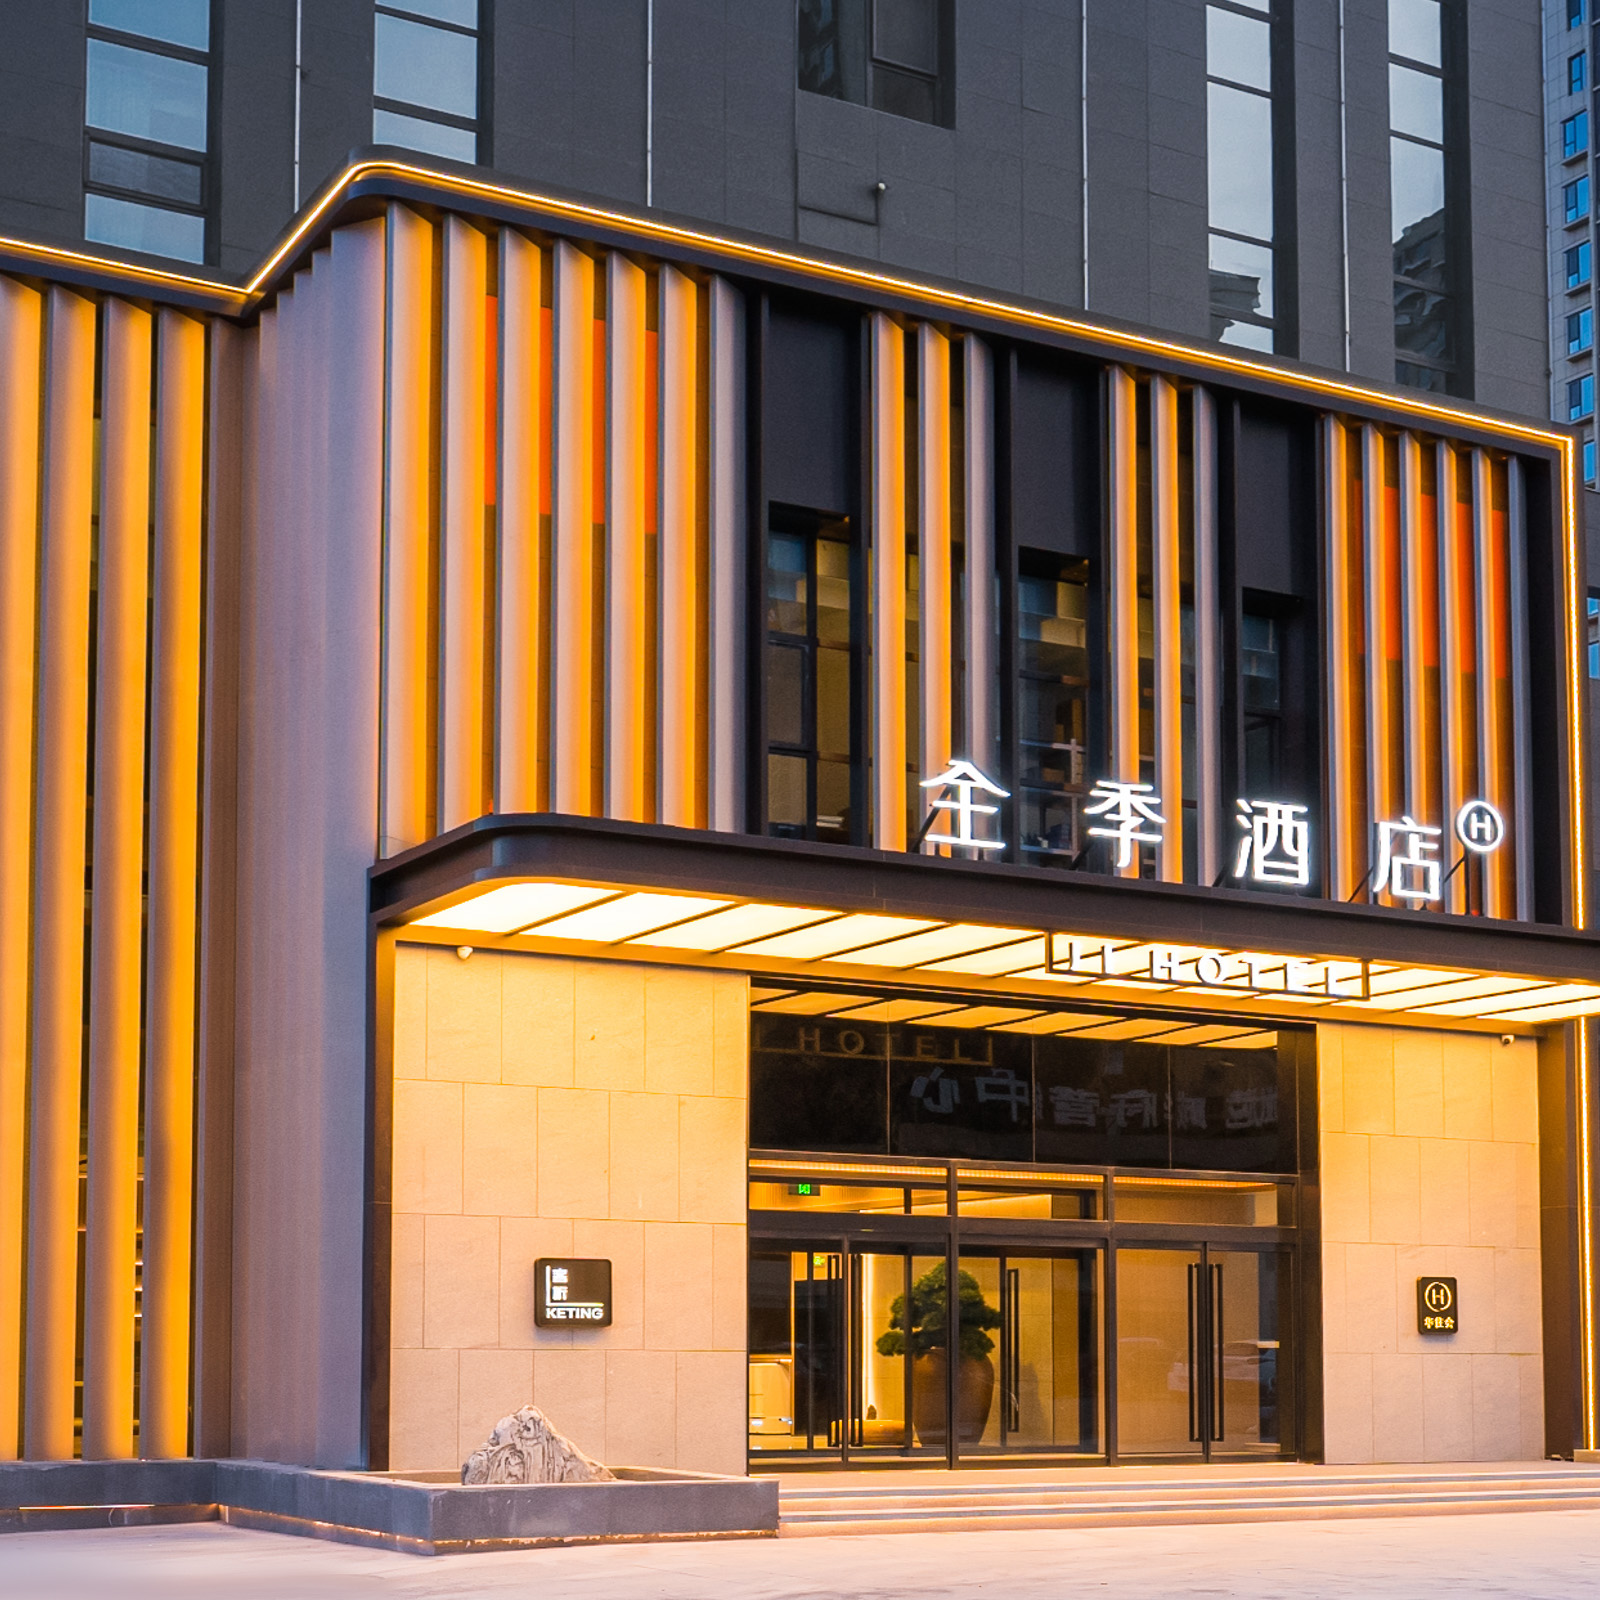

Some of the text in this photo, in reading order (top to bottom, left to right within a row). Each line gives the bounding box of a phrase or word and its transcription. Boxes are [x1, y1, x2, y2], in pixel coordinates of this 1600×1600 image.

[920, 759, 1442, 901] 全季酒店
[545, 1307, 604, 1319] KETING
